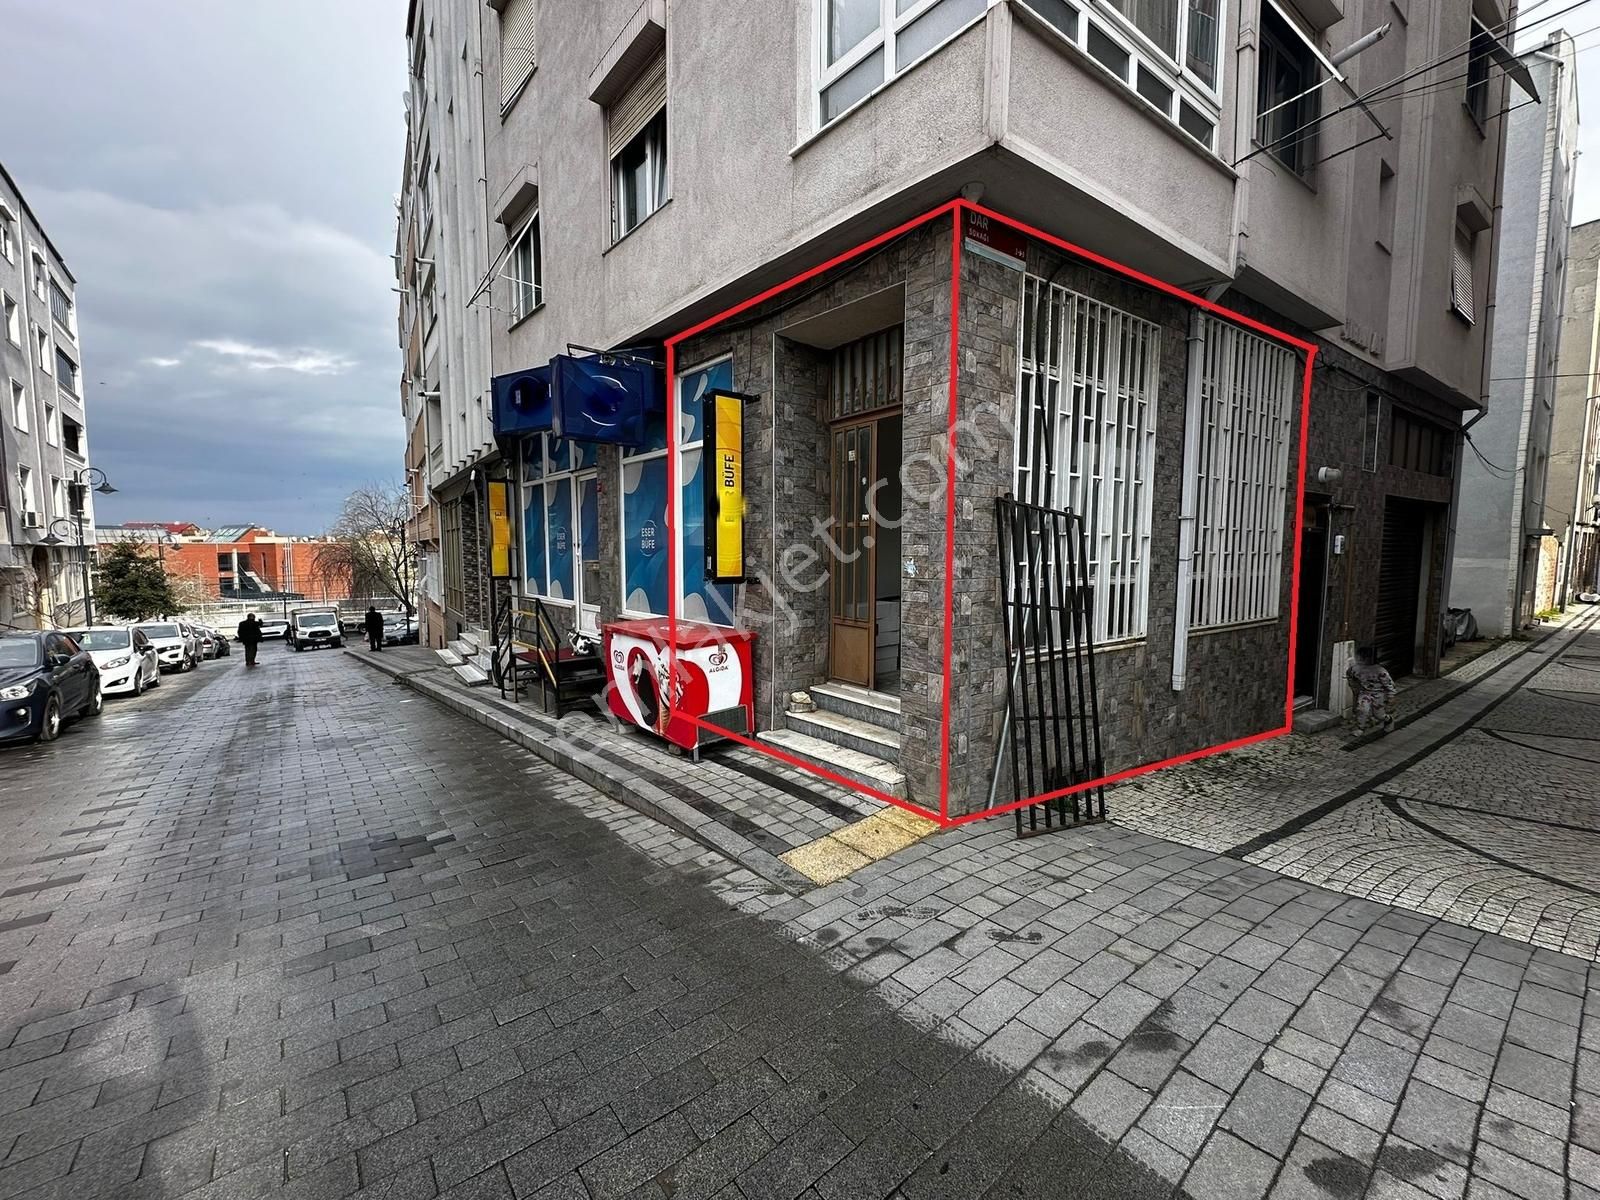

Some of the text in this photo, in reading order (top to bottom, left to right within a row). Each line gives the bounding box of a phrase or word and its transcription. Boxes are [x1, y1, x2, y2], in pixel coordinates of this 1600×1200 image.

[970, 212, 989, 230] DAR
[721, 454, 735, 488] BÜFE
[641, 527, 655, 537] ESER
[641, 537, 655, 549] BÜFE
[709, 665, 729, 673] ALGIDA
